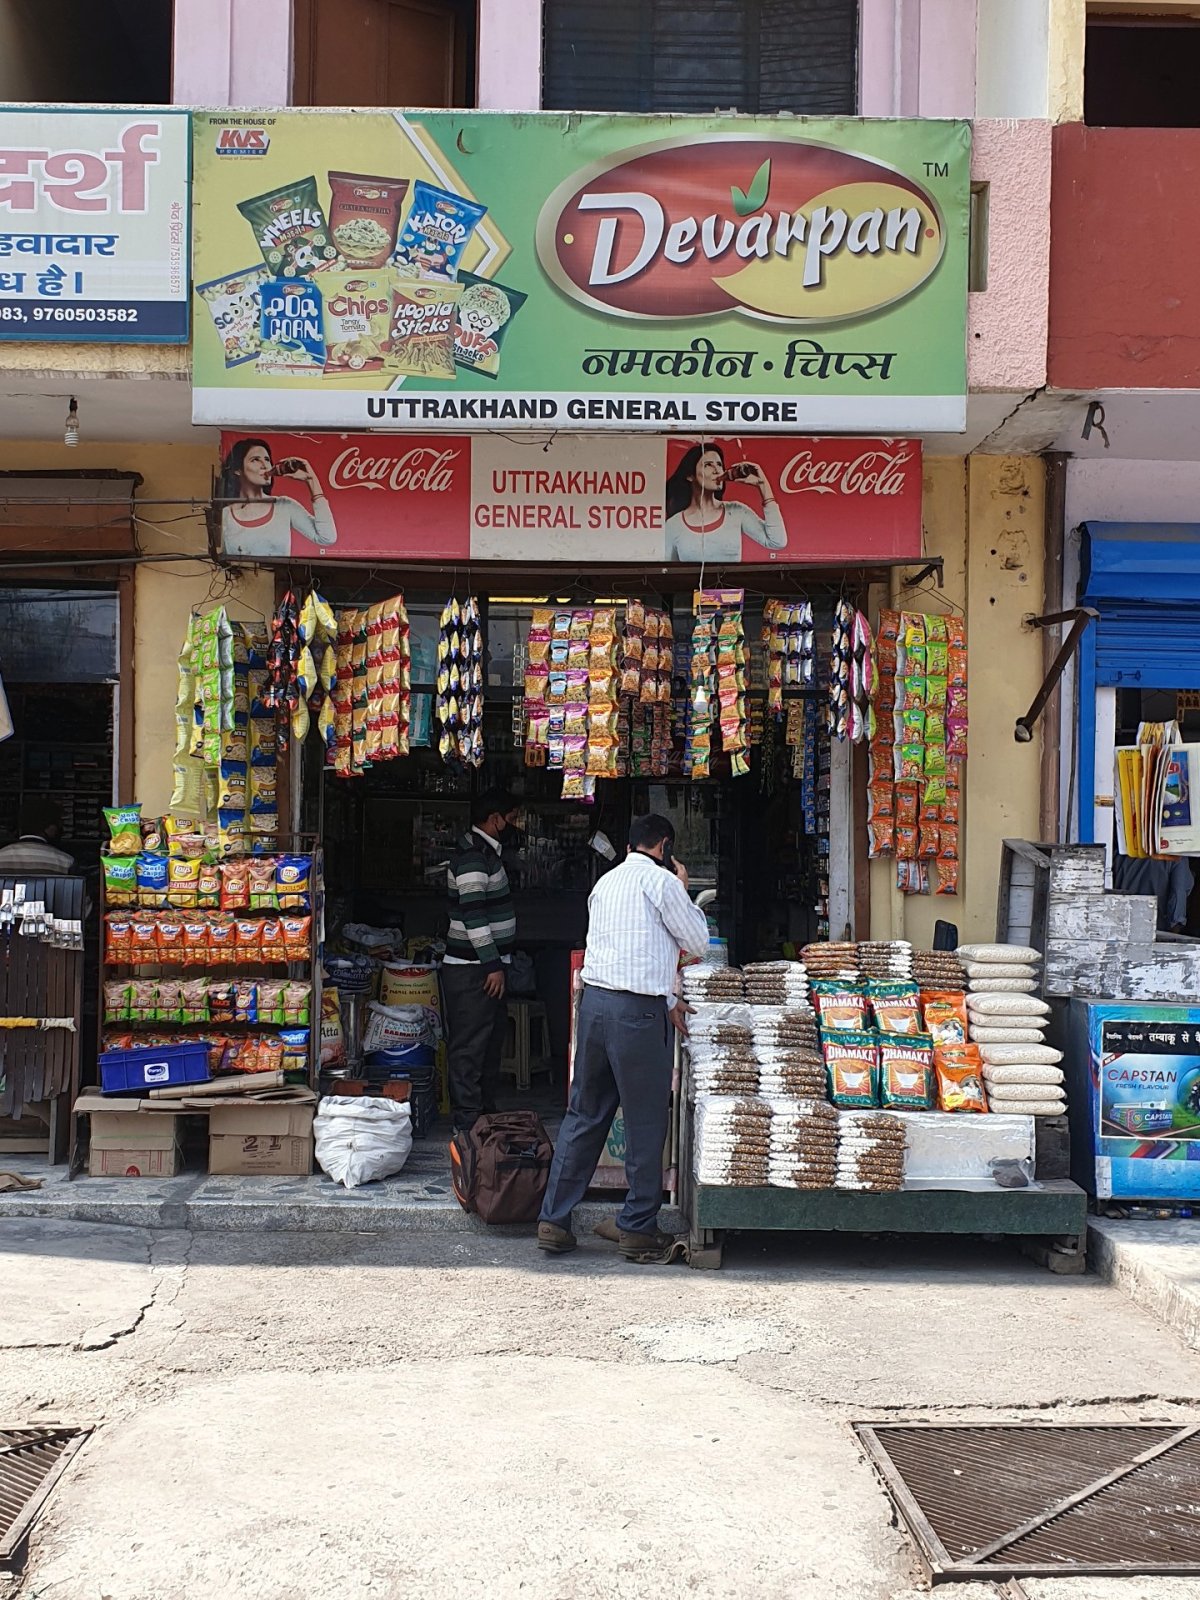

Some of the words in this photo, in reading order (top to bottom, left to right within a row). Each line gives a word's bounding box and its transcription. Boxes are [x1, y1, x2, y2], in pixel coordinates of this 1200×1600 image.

[243, 118, 266, 126] HOUSE
[267, 118, 277, 126] OF
[220, 130, 265, 147] KVS
[923, 162, 950, 178] TM
[260, 208, 321, 247] WHEELS
[280, 226, 305, 242] Masala
[408, 212, 468, 245] KATORI
[424, 228, 449, 241] Masala
[577, 191, 922, 287] Devarpan
[33, 308, 138, 322] 9760503582
[328, 295, 388, 319] Chips
[394, 302, 453, 321] Hoopla
[270, 319, 323, 342] CORN
[391, 319, 450, 339] Sticks
[453, 344, 484, 362] snacks
[581, 338, 759, 377] नमकीन
[784, 339, 897, 380] चिप्स
[367, 398, 558, 419] UTTRAKHAND
[566, 399, 697, 421] GENERAL
[705, 401, 798, 422] STORE
[328, 446, 462, 491] Coca-Cola
[779, 450, 914, 496] Coca-Cola
[492, 470, 646, 495] UTTRAKHAND
[475, 504, 582, 530] GENERAL
[588, 505, 663, 529] STORE
[820, 997, 865, 1009] DHAMAKA
[872, 997, 918, 1009] DHAMAKA
[1148, 1032, 1176, 1046] तम्बाकू
[1181, 1031, 1190, 1043] से
[828, 1046, 877, 1063] DHAMAKA
[881, 1047, 930, 1065] DHAMAKA
[1107, 1069, 1178, 1083] CAPSTAN
